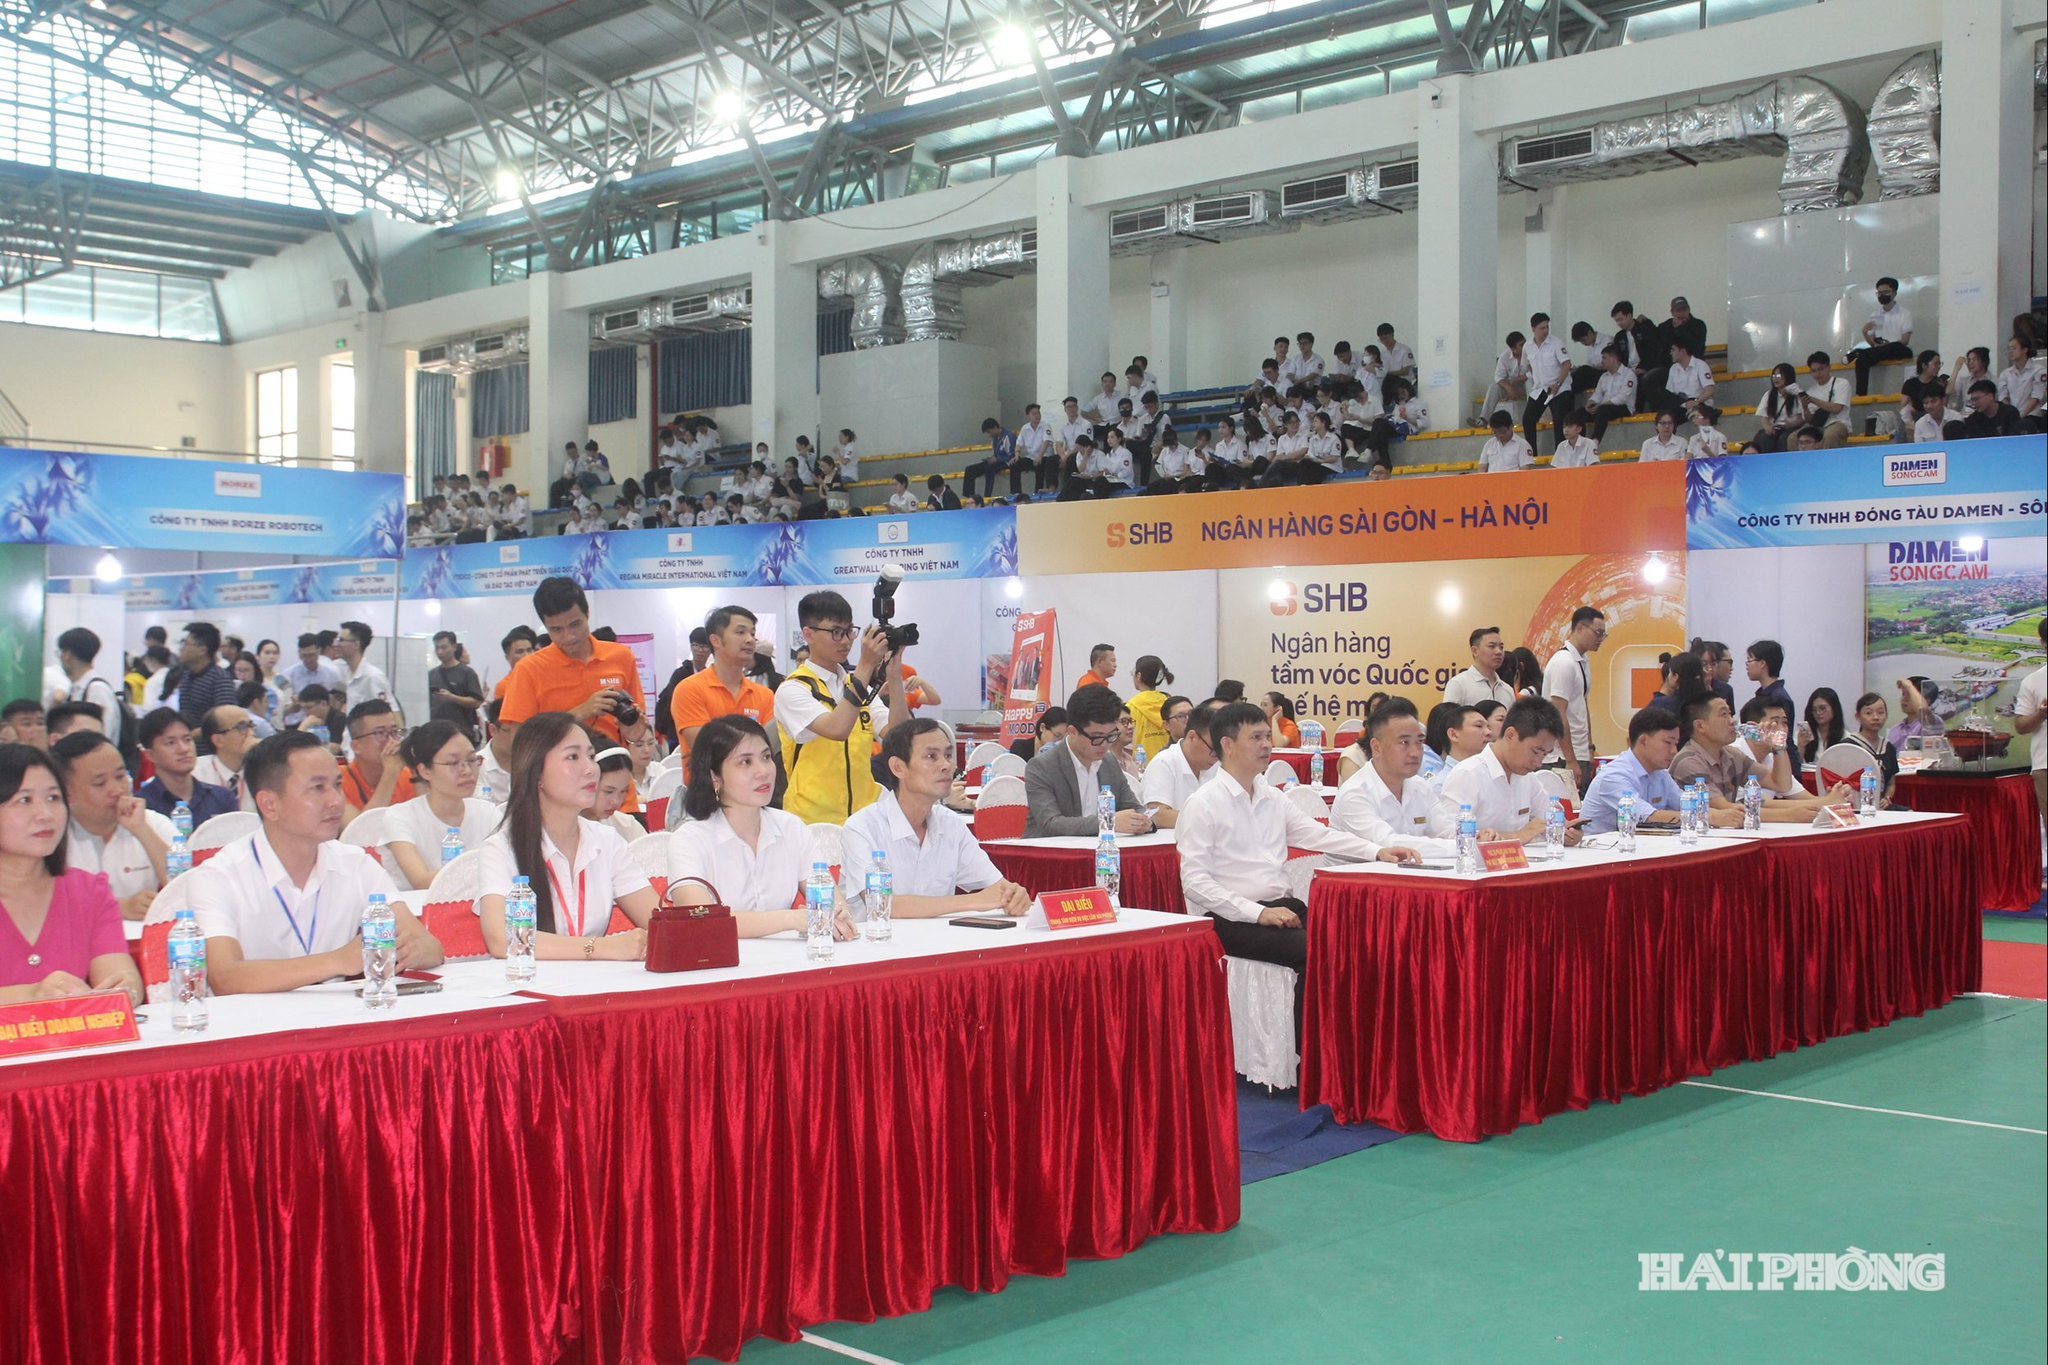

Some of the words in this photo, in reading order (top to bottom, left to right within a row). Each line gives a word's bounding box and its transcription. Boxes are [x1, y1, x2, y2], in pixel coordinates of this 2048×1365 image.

[1891, 459, 1938, 471] DAMEN
[1891, 470, 1938, 480] SONGCAM
[150, 514, 181, 525] CÔNG
[184, 517, 197, 526] TY
[200, 518, 229, 527] TNHH
[232, 519, 266, 529] RORZE
[268, 521, 323, 531] ROBOTECH
[1201, 514, 1262, 541] NGÂN
[1268, 511, 1333, 538] HÀNG
[1339, 507, 1377, 535] SÀI
[1383, 505, 1436, 533] GÒN
[1461, 500, 1498, 528] HÀ
[1503, 497, 1548, 530] NỘI
[1737, 513, 1780, 528] CÔNG
[1784, 514, 1803, 525] TY
[1808, 511, 1850, 524] TNHH
[1855, 506, 1901, 522] ĐÓNG
[1906, 504, 1938, 520] TÀU
[1943, 504, 2003, 518] DAMEN
[1129, 522, 1173, 545] SHB
[865, 548, 888, 558] CÔNG
[890, 549, 899, 557] TY
[901, 548, 924, 557] TNHH
[1889, 540, 1988, 564] DAMEN
[659, 558, 676, 567] CÔNG
[833, 565, 880, 575] GREATWALL
[920, 560, 938, 572] VIỆT
[940, 560, 959, 569] NAM
[641, 572, 667, 580] MIRACLE
[668, 571, 717, 579] INTERNATIONAL
[1889, 564, 1988, 581] SONGCAM
[1303, 582, 1368, 613] SHB
[995, 605, 1021, 618] CÔNG
[1271, 632, 1327, 659] Ngân
[1334, 631, 1391, 659] hàng
[1271, 659, 1314, 685] tầm
[1319, 662, 1361, 685] vóc
[1366, 659, 1429, 685] Quốc
[1313, 694, 1341, 721] hệ
[1007, 722, 1036, 735] MOOD
[18, 1015, 46, 1038] BIỂU
[46, 1015, 86, 1035] DOANH
[85, 1008, 126, 1030] NGHIỆP
